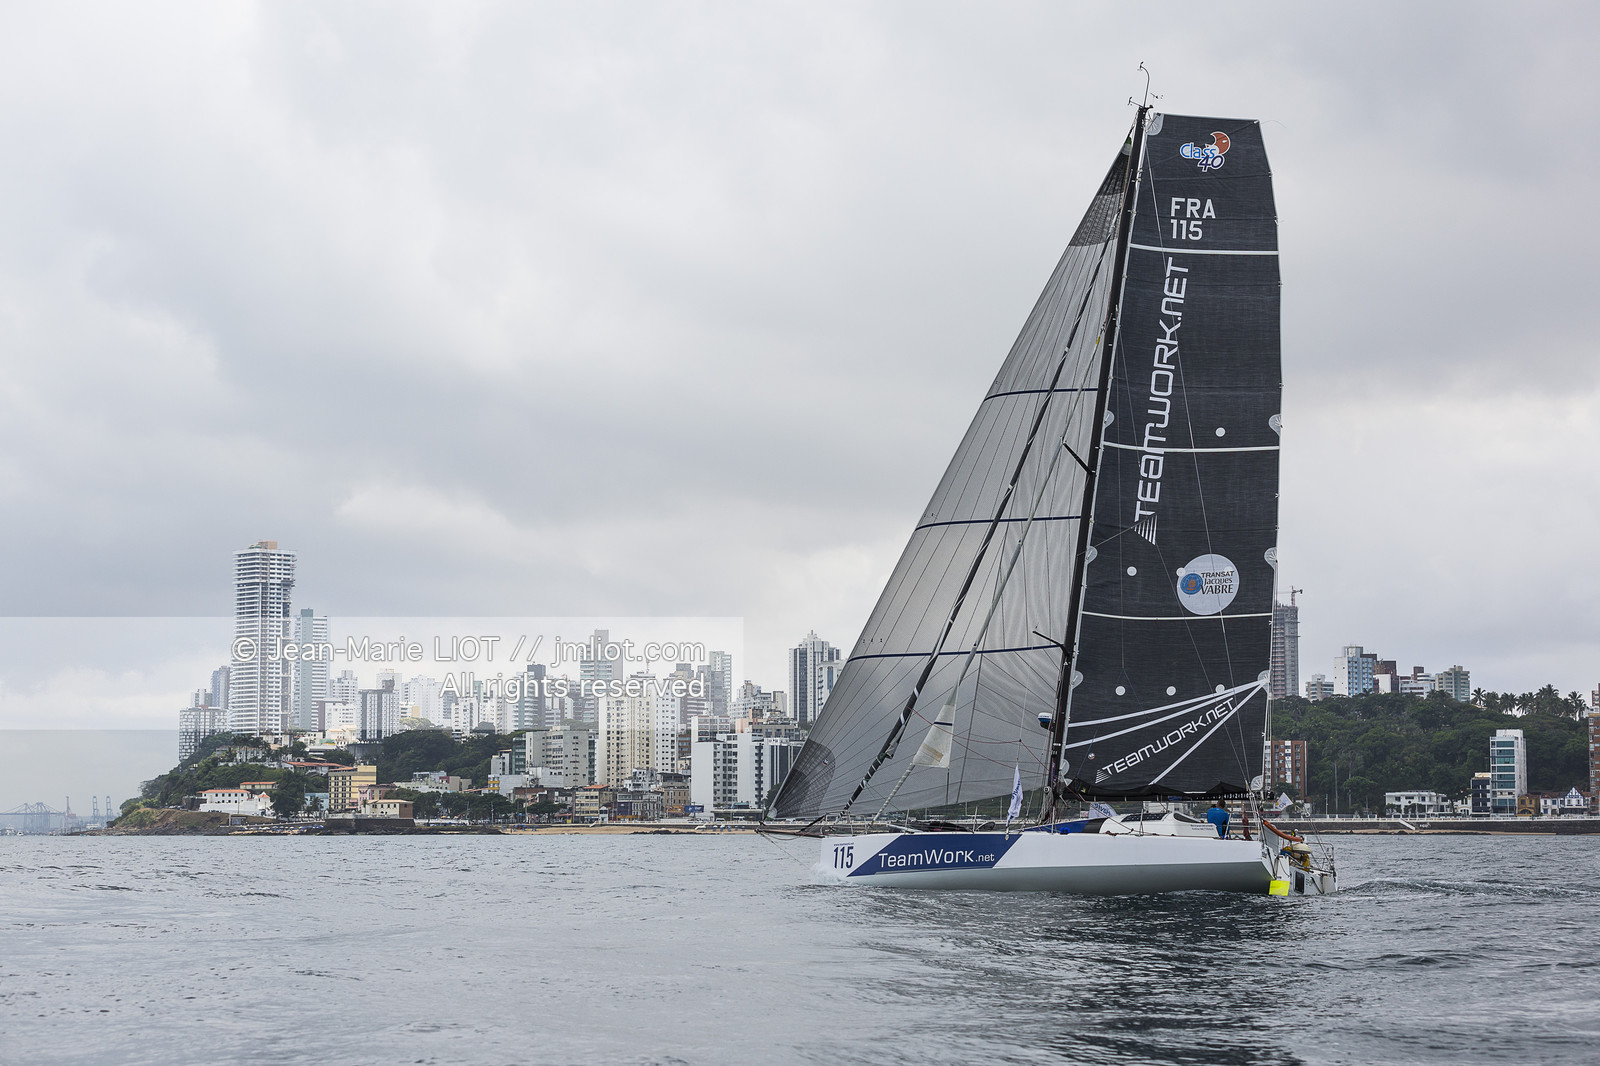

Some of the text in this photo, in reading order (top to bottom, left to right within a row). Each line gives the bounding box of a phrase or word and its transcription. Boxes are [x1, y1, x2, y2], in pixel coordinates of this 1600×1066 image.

[1180, 143, 1216, 159] Class
[1198, 155, 1224, 171] 40
[1171, 197, 1216, 219] FRA
[1170, 219, 1203, 240] 115
[1201, 570, 1235, 578] TRANSAT
[1204, 577, 1233, 586] Jacques
[1200, 584, 1234, 595] VABRE
[833, 846, 854, 869] 115
